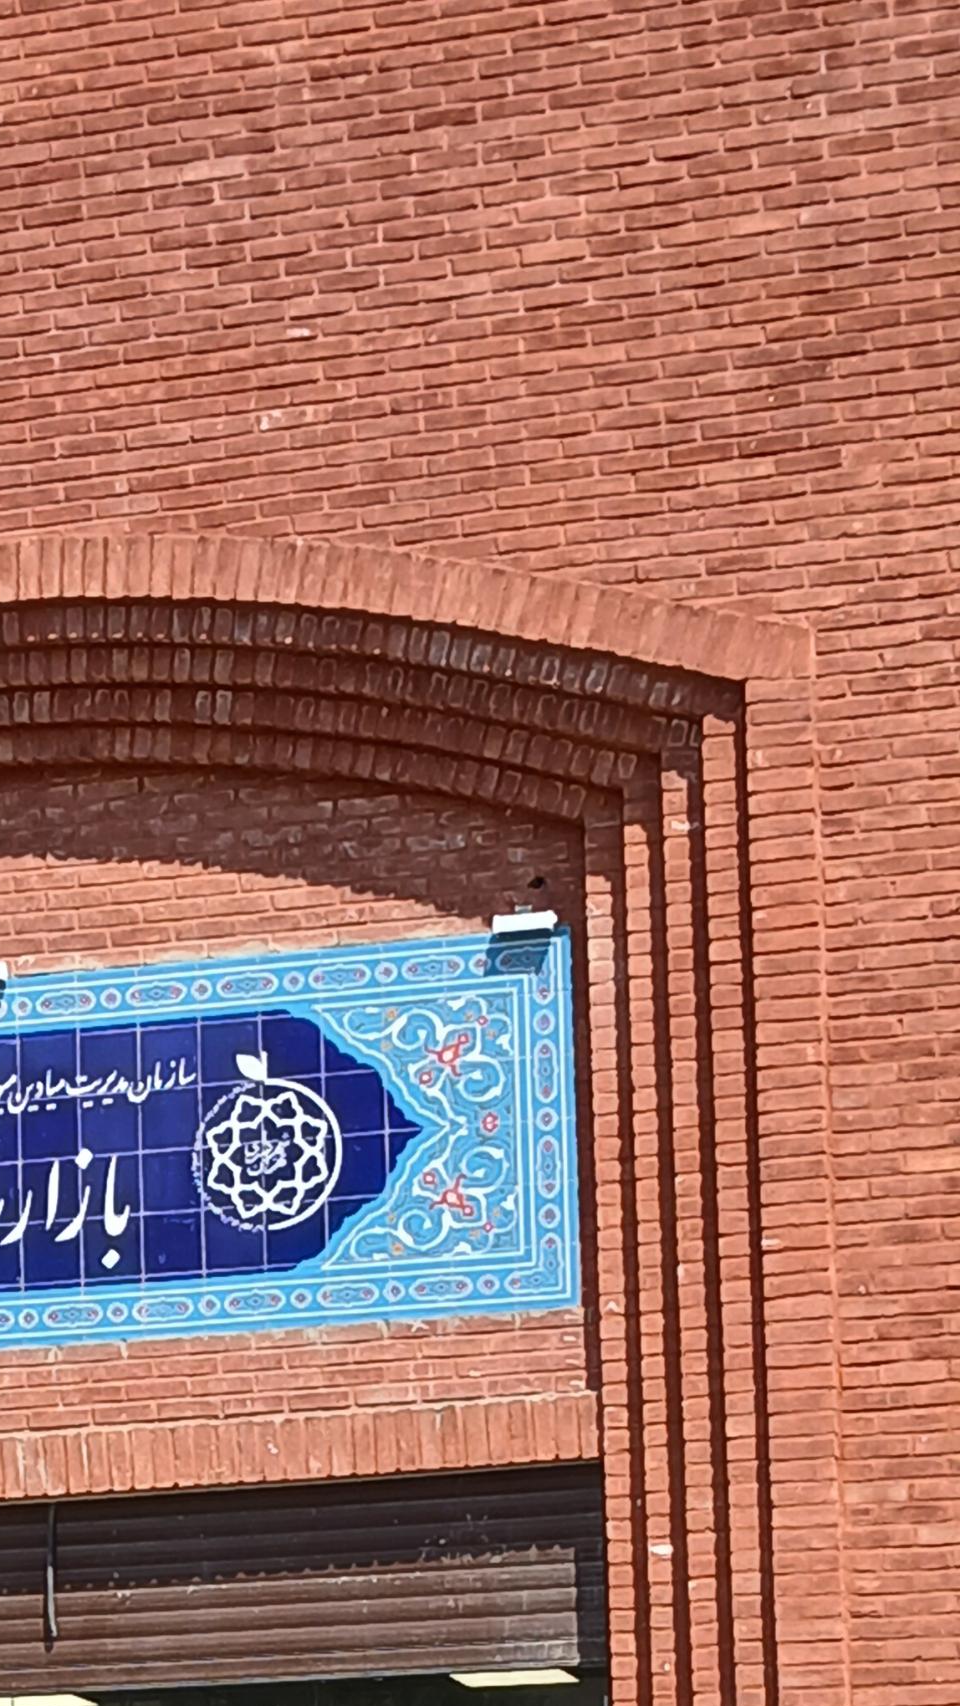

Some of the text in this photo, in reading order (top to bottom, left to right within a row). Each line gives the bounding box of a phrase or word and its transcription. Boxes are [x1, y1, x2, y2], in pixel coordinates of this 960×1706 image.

[6, 1068, 66, 1114] میادین
[65, 1069, 129, 1109] مدیریت
[127, 1057, 197, 1103] سازمان
[0, 1147, 131, 1270] بازار
